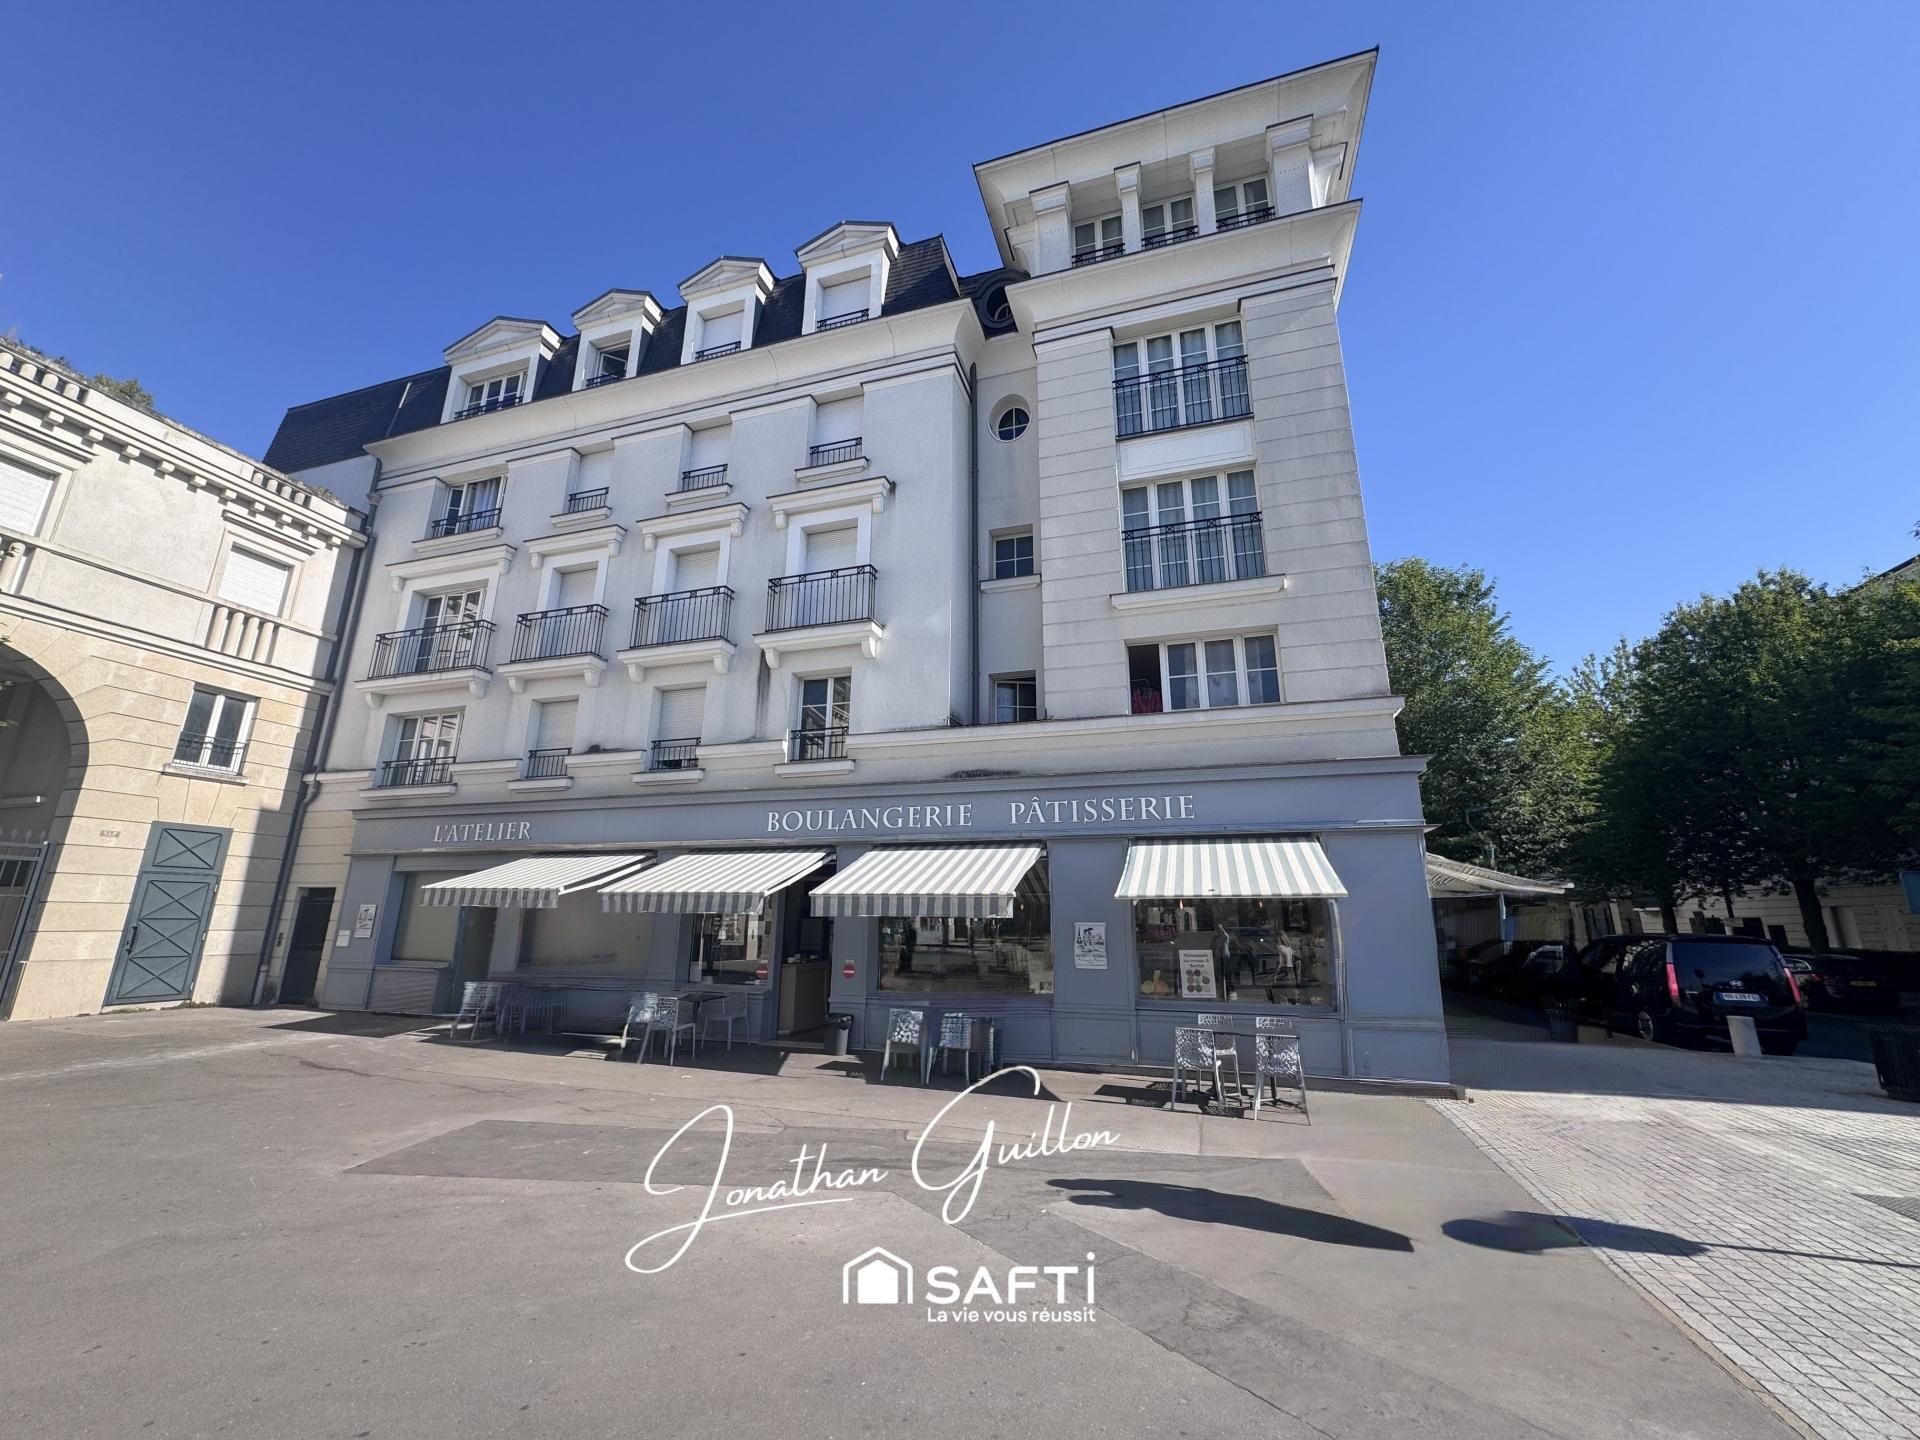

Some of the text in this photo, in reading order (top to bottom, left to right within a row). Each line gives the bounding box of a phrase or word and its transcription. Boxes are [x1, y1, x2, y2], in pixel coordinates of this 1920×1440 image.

[767, 795, 1196, 832] BOULANGERIE PÂTISSERIE
[433, 821, 532, 843] L'ATELIER
